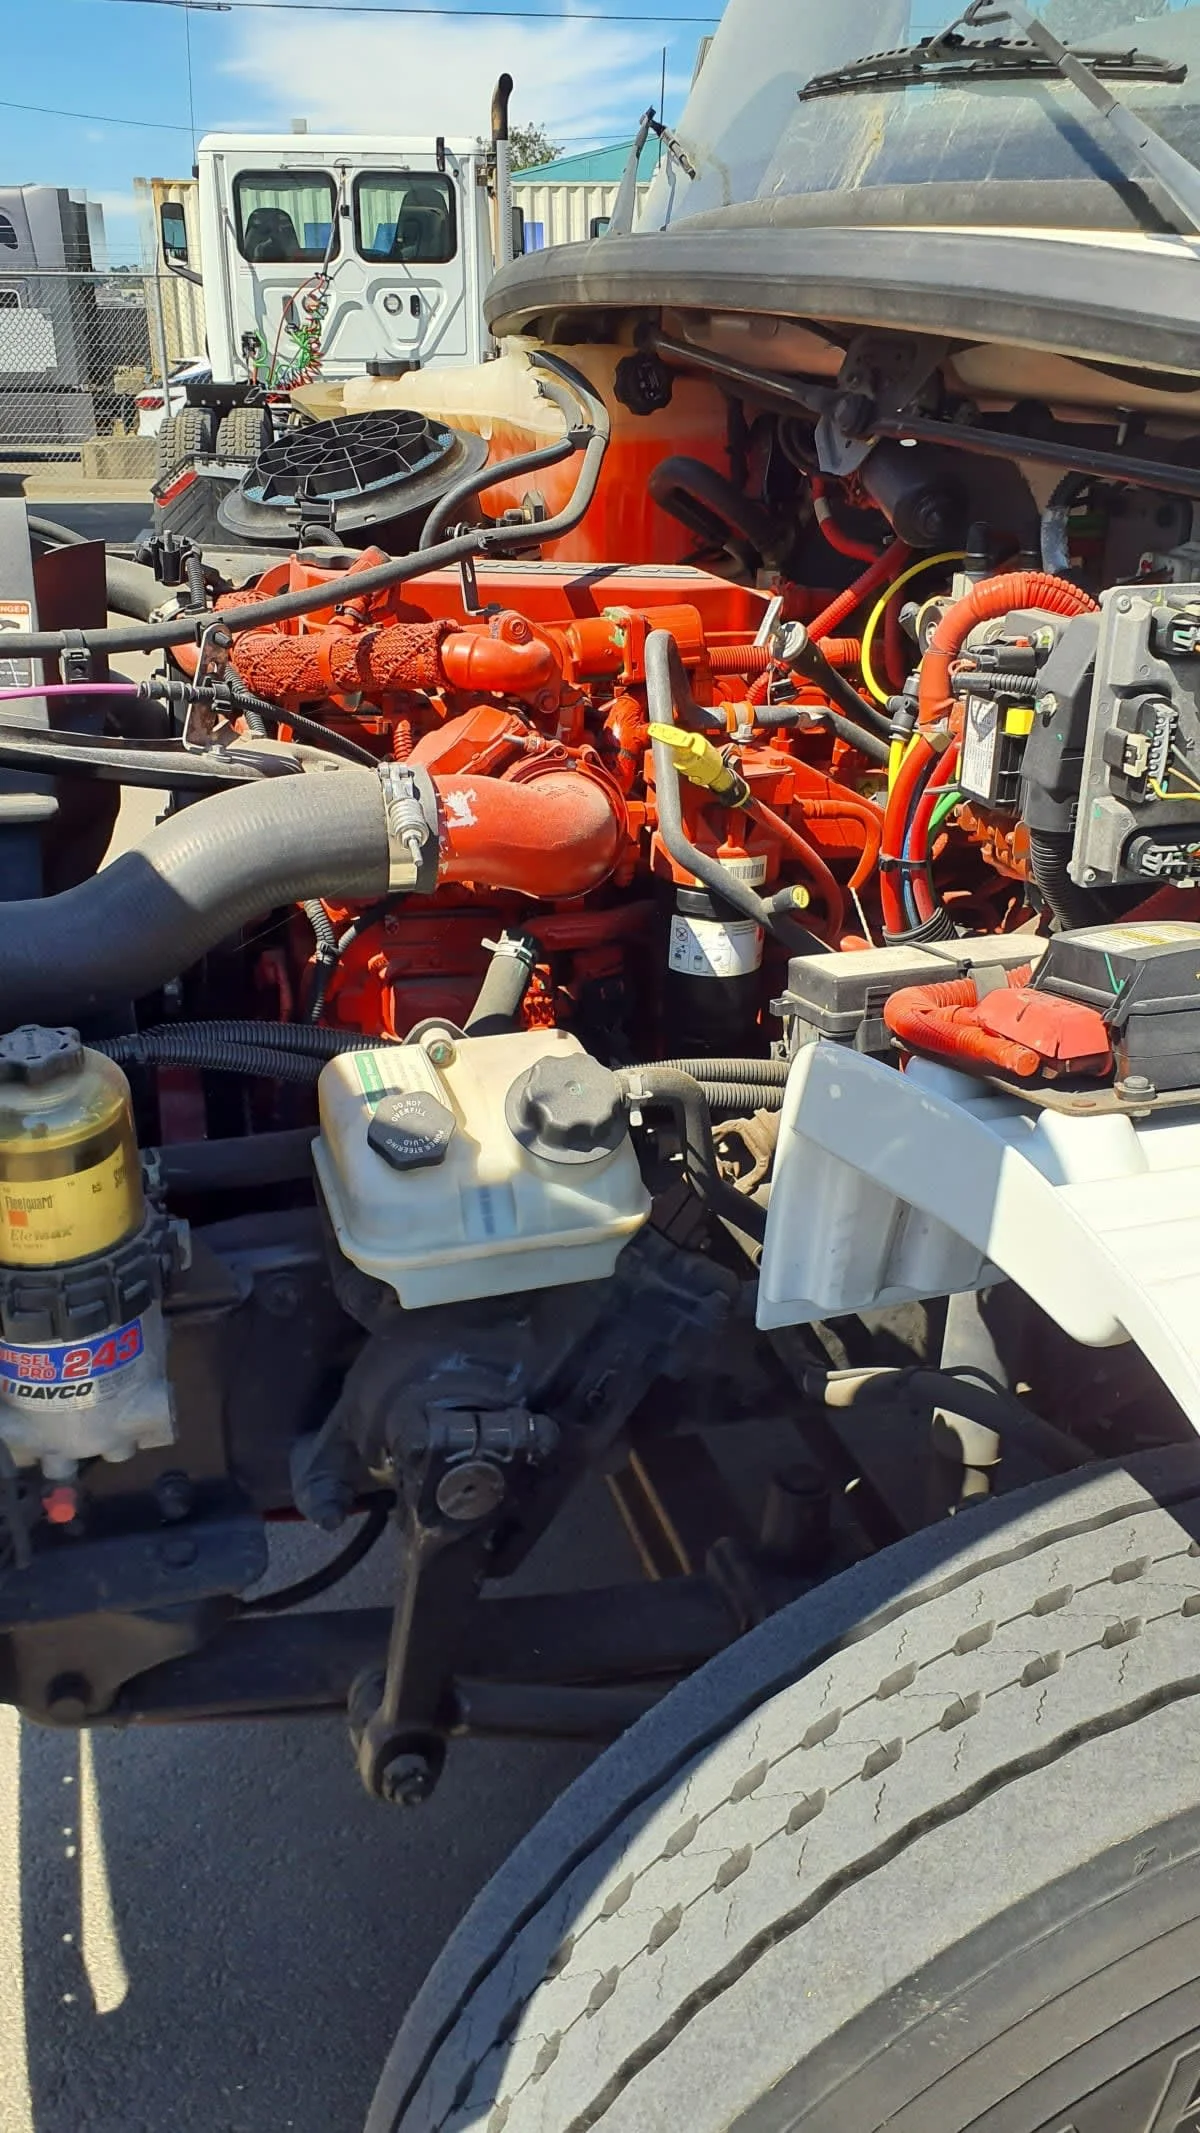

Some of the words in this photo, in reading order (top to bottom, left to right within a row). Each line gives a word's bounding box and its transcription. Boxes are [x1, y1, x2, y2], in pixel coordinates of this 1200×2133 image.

[391, 1107, 428, 1122] OVERFILL
[385, 1138, 424, 1153] STEERING
[424, 1129, 444, 1151] POWER
[61, 1328, 140, 1380] 243
[18, 1365, 56, 1380] PRO
[17, 1382, 94, 1400] DAVCO
